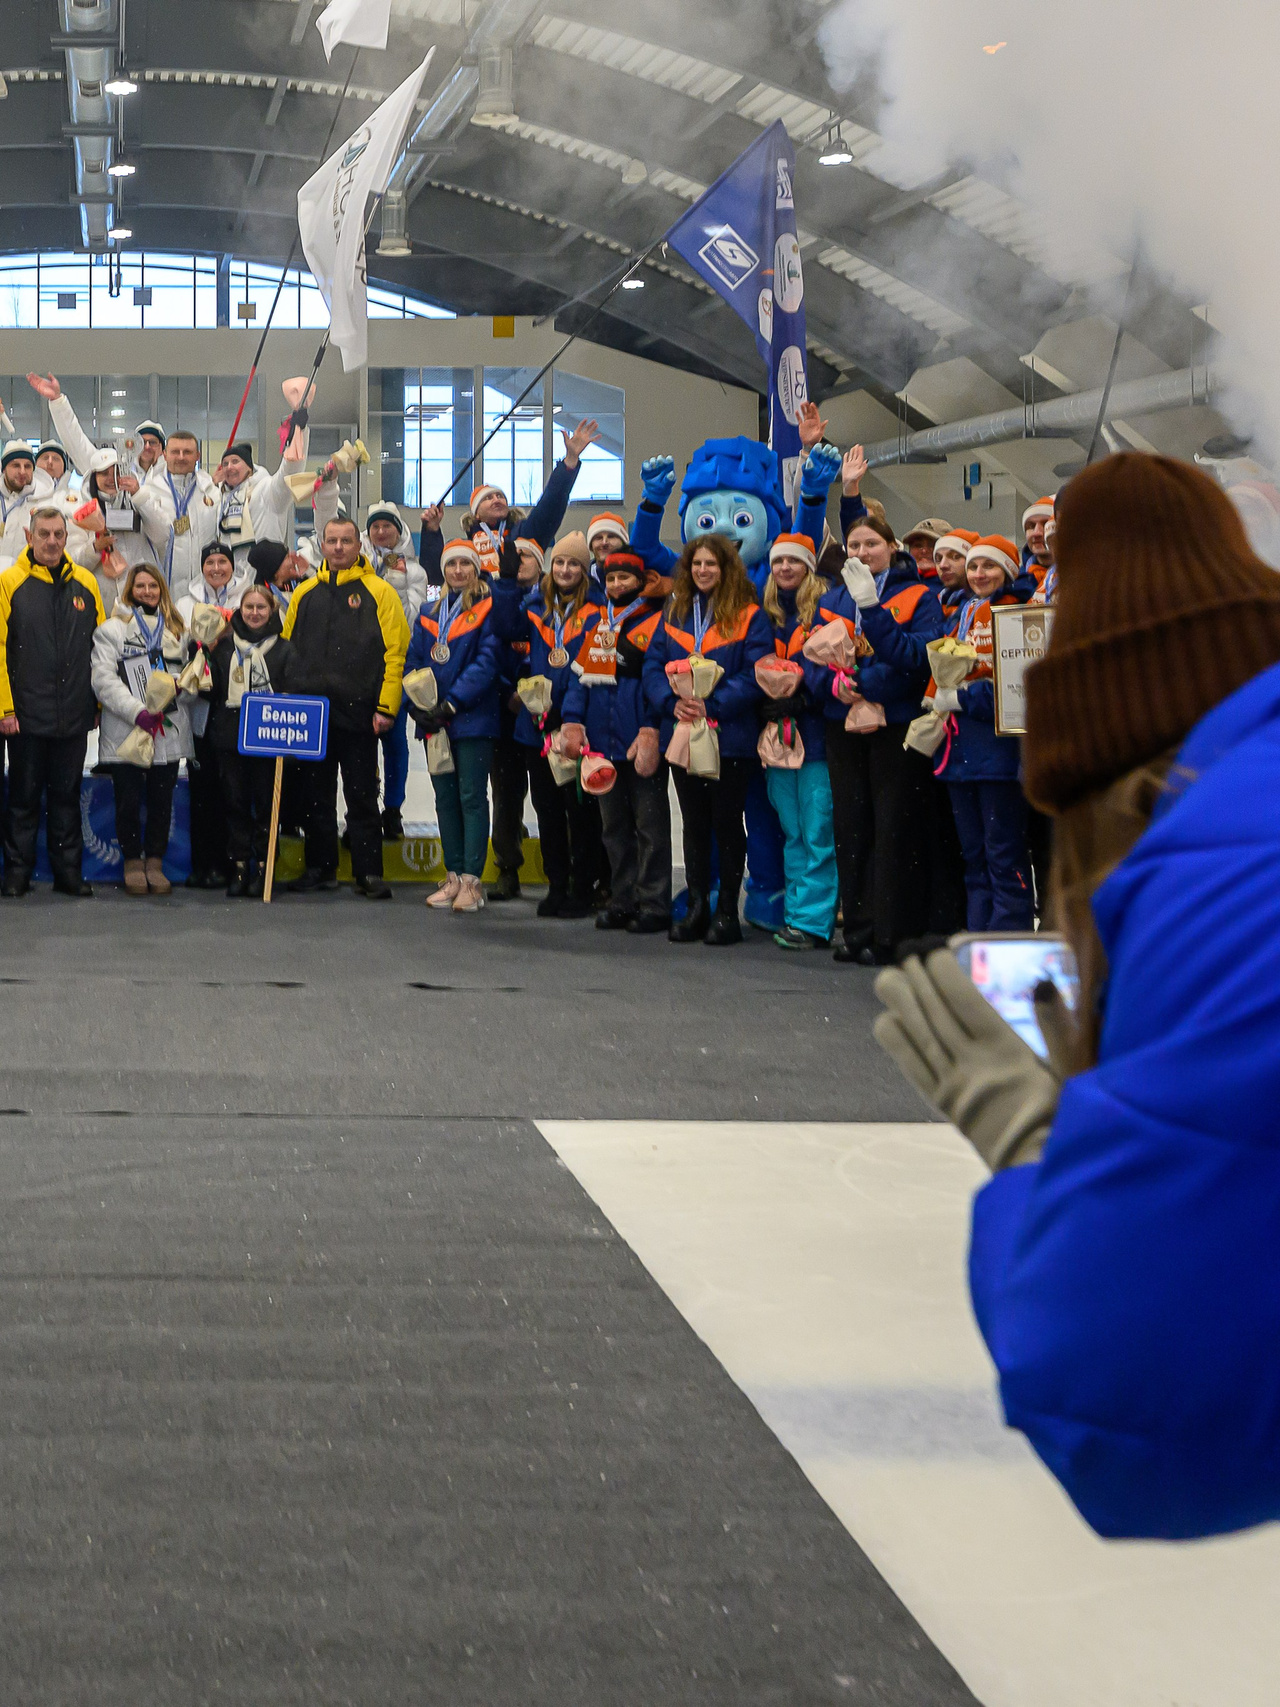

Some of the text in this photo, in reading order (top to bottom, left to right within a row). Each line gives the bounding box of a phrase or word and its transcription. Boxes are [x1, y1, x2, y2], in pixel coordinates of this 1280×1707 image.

[1001, 647, 1045, 660] СЕРТИФ
[262, 705, 308, 726] Белые
[257, 727, 309, 747] тигры
